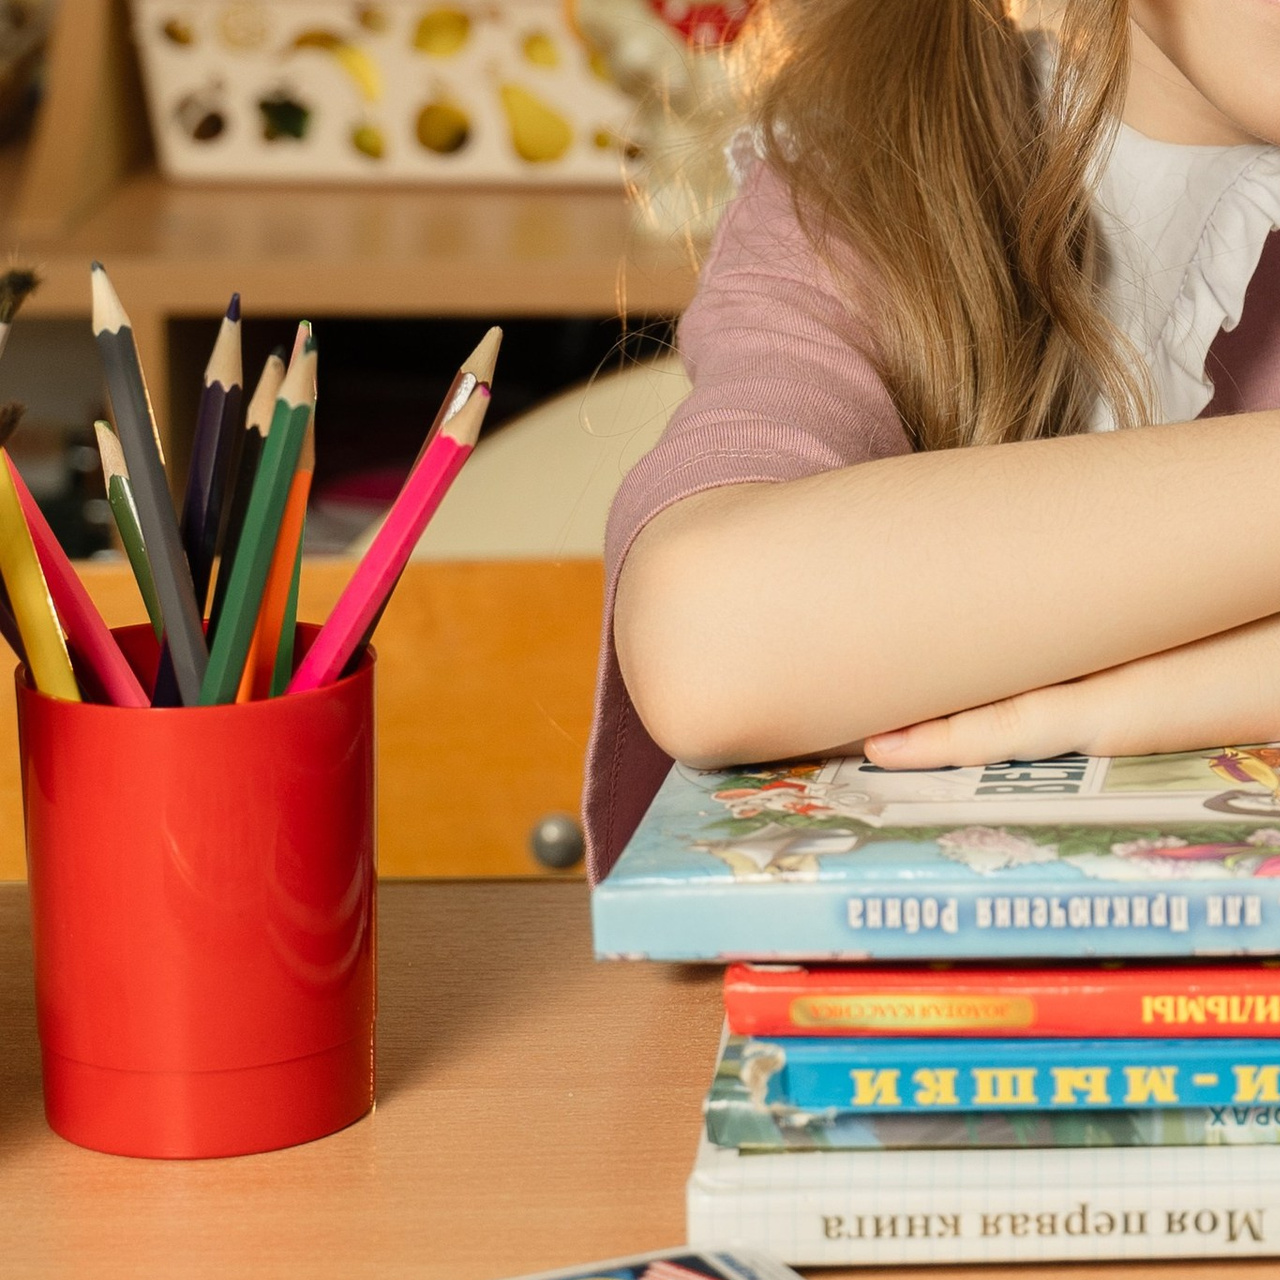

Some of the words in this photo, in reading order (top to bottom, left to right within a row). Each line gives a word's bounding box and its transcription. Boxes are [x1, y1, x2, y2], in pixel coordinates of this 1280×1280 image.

[846, 895, 958, 934] Робина
[974, 892, 1190, 933] Приключения
[1206, 894, 1262, 928] или
[821, 1213, 962, 1240] книга
[979, 1202, 1147, 1238] первая
[1164, 1207, 1268, 1244] Моя
